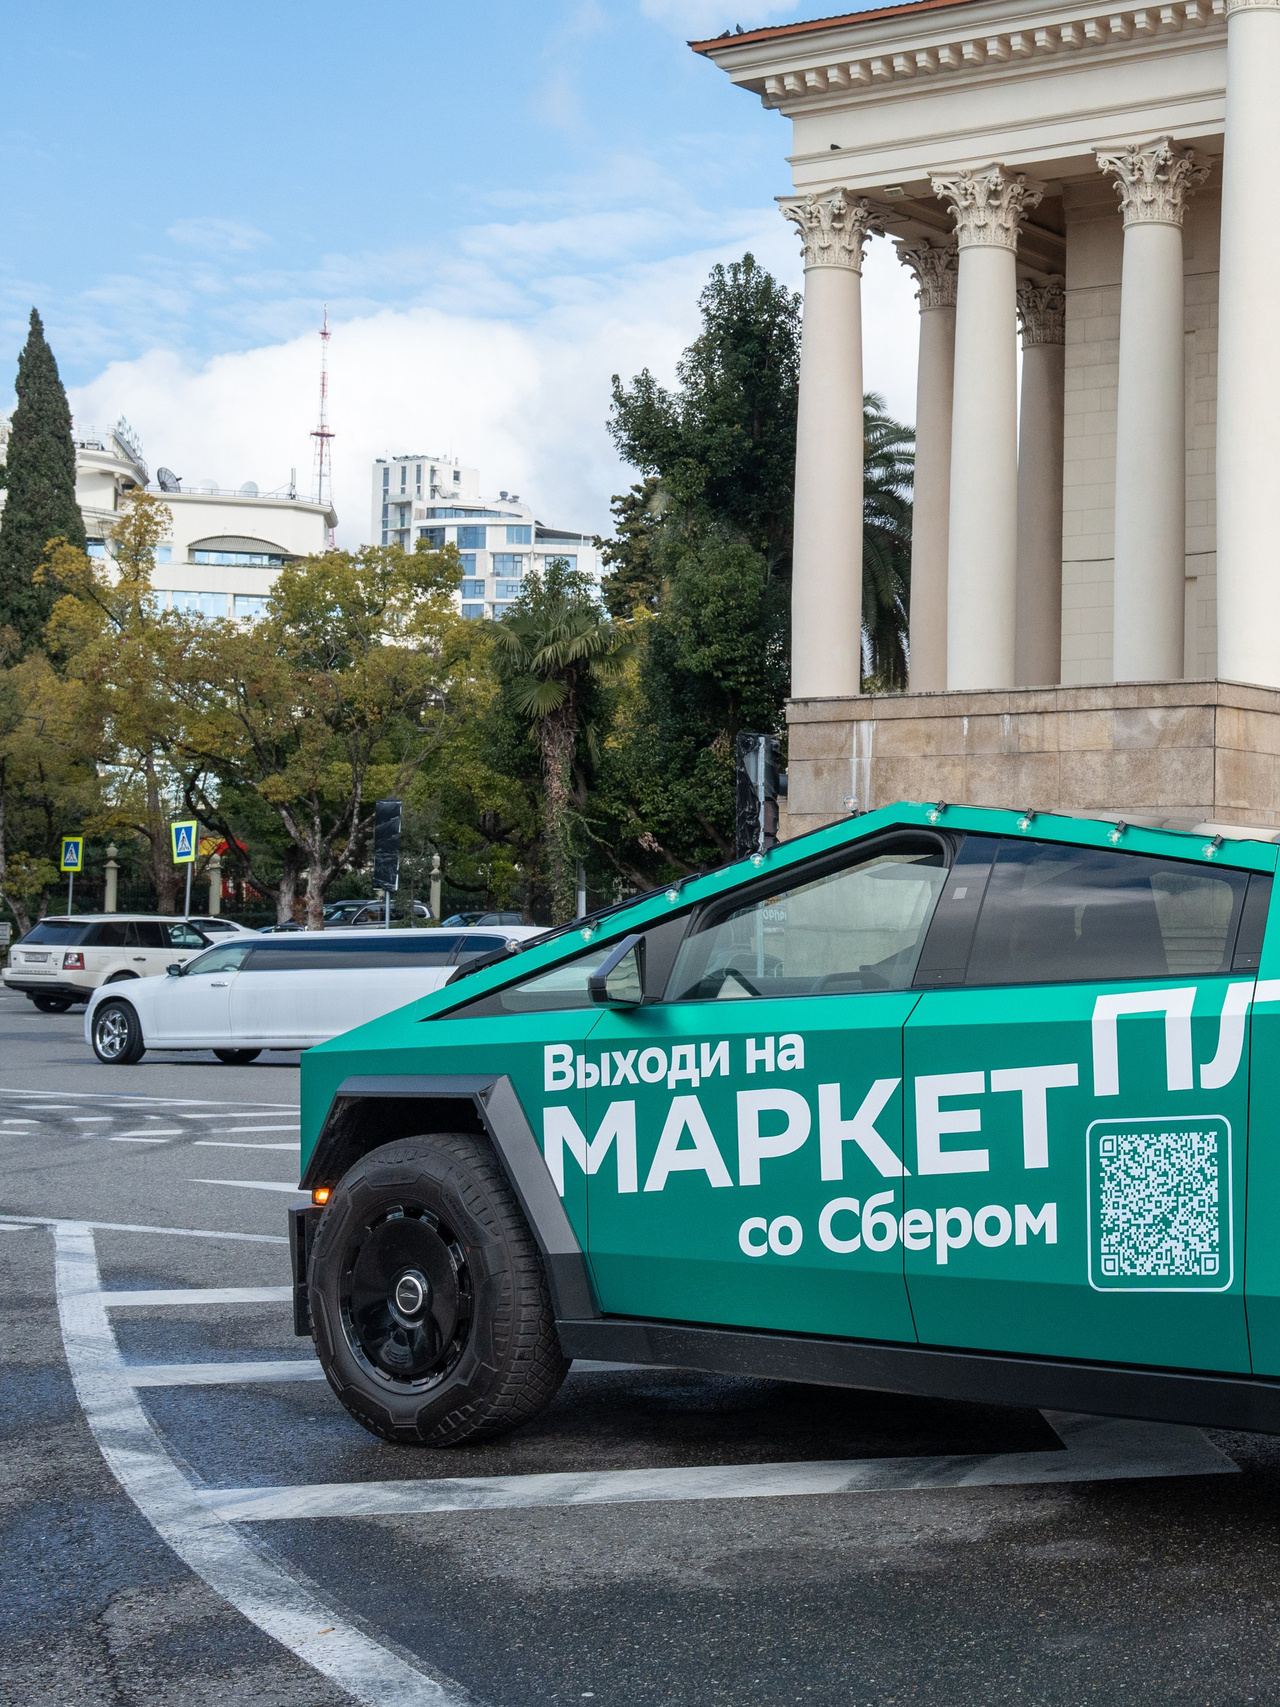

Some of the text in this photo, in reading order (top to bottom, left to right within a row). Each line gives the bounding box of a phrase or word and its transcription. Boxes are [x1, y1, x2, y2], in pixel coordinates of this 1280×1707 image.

[543, 1033, 805, 1092] Выходи на
[738, 1190, 1058, 1265] со Сбером
